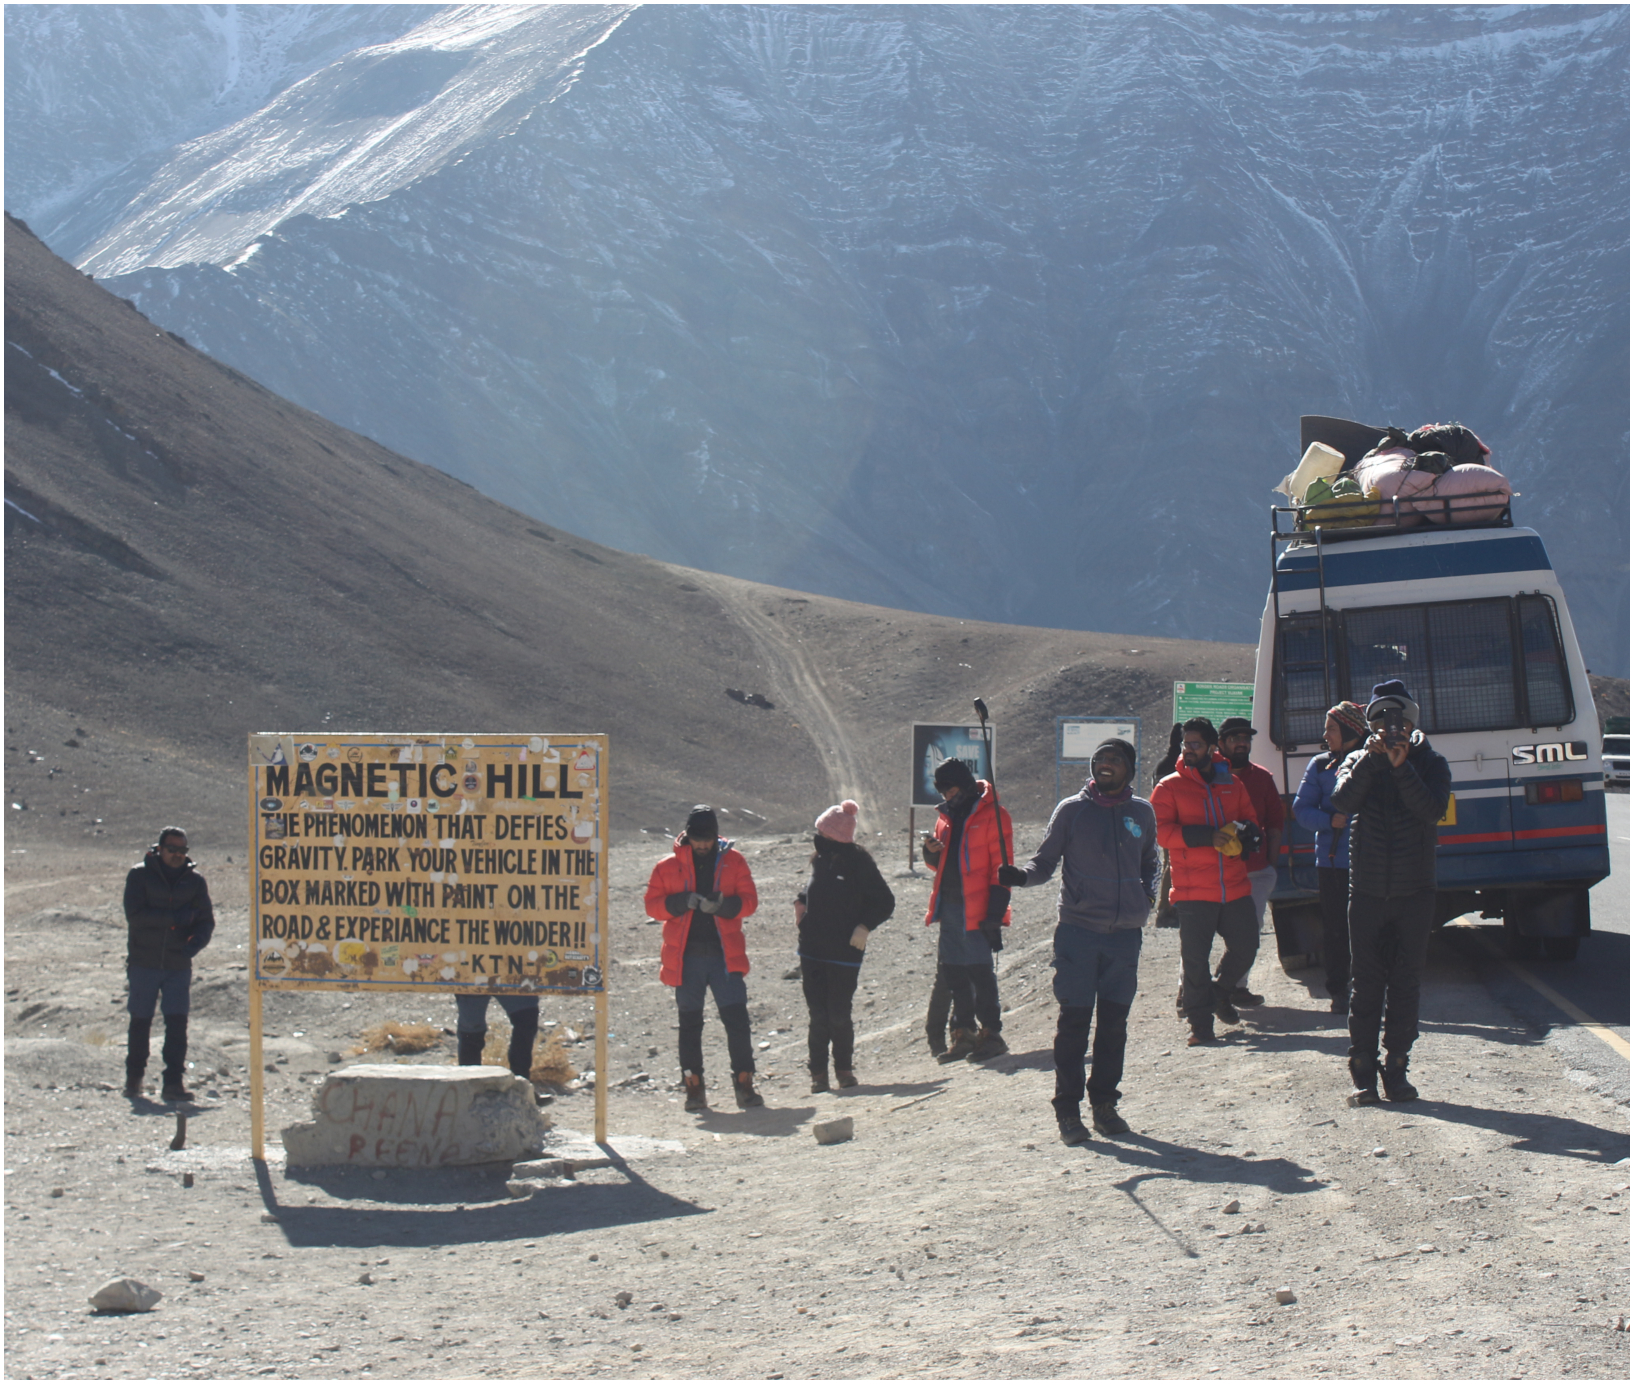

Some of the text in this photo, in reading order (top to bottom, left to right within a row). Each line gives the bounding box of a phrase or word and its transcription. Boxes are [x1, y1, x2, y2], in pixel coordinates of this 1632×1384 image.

[956, 745, 980, 759] SAVE
[1512, 742, 1587, 765] SML
[266, 762, 584, 799] MAGNETIC HILL
[304, 813, 427, 838] PHENOMENON
[433, 814, 487, 840] THAT
[495, 814, 568, 841] DEFIES
[259, 845, 595, 876] GRAVITY. PARK YOUR VEHICLE IN THE
[261, 879, 580, 910] BOX MARKED WITH PAINT ON THE
[262, 914, 313, 940] ROAD
[315, 915, 332, 941] &
[335, 916, 450, 944] EXPERIANCE
[455, 919, 490, 945] THE
